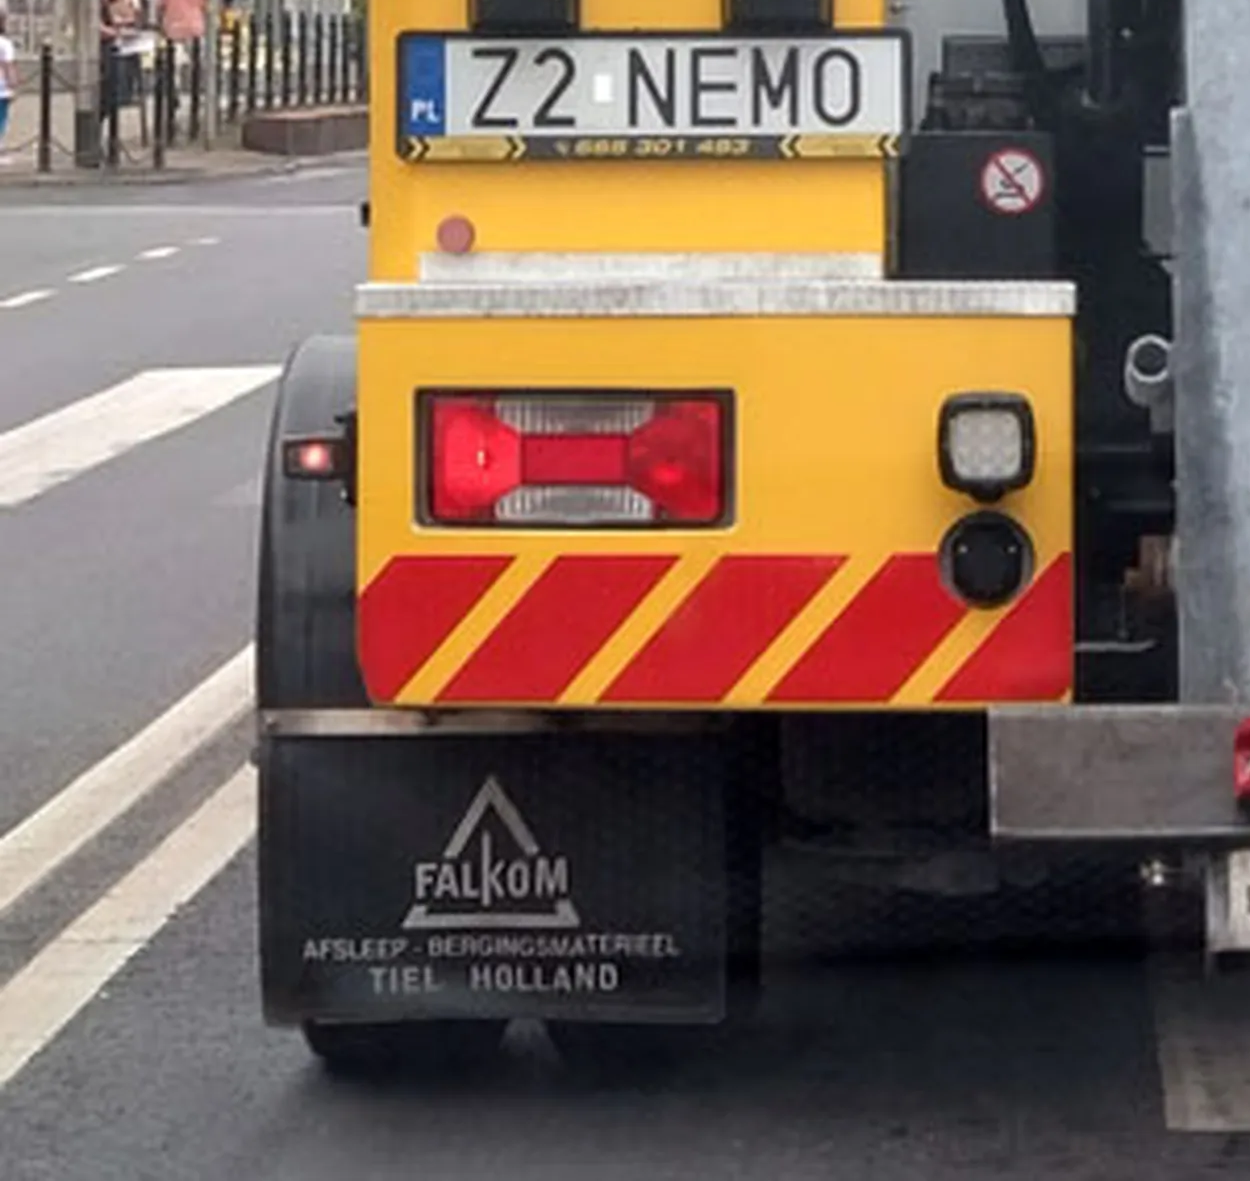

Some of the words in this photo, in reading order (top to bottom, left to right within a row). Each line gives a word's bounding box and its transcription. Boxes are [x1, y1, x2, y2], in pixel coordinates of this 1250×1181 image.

[471, 47, 577, 128] Z2
[628, 47, 861, 128] NEMO
[411, 100, 440, 122] PL
[633, 138, 687, 156] 301
[414, 830, 570, 907] FALKOM
[368, 966, 445, 995] TIEL
[470, 963, 619, 993] HOLLAND
